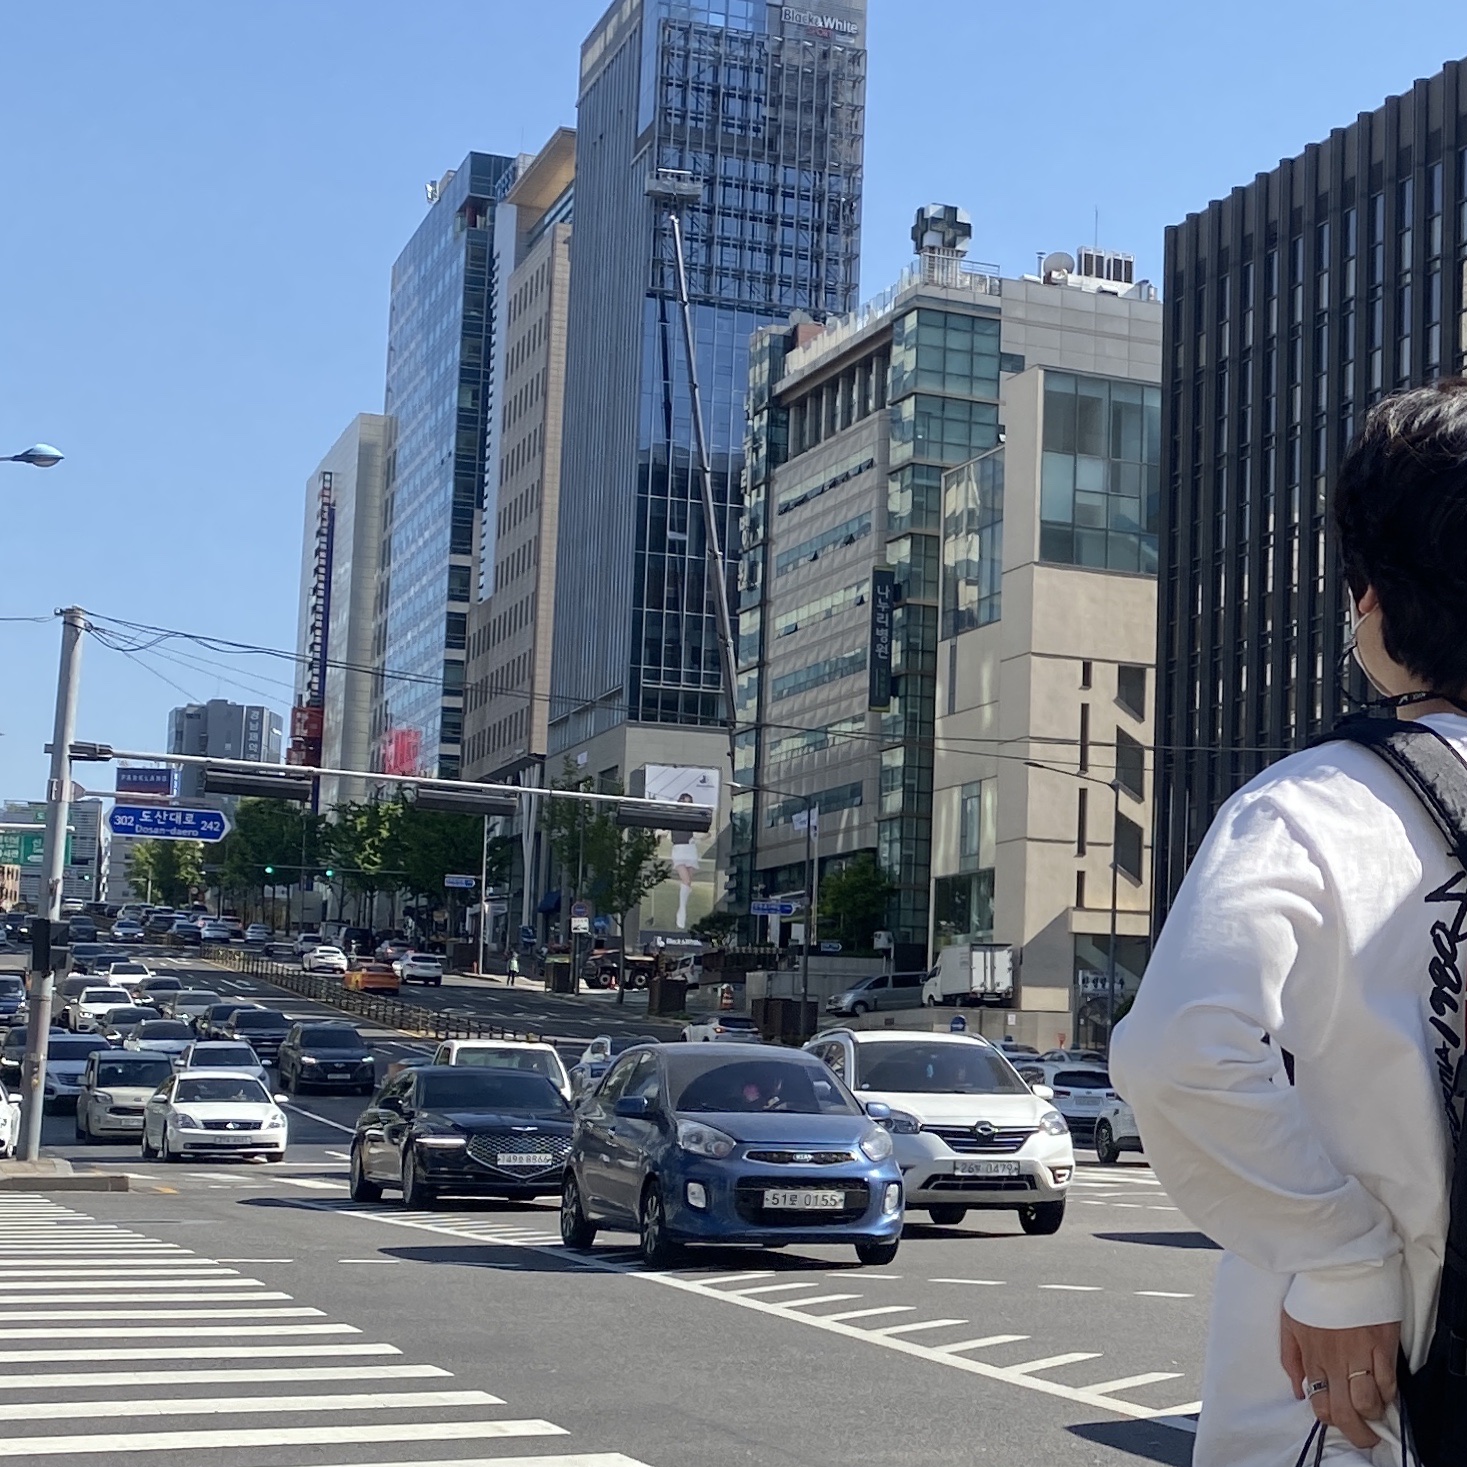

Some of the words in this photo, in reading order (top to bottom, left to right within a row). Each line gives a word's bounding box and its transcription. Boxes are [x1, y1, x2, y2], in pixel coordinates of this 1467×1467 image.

[876, 585, 890, 659] 나누리병원
[114, 814, 134, 826] 302
[139, 810, 196, 825] 도산대로
[201, 820, 221, 832] 242
[135, 824, 199, 837] Dosan-daero
[804, 1193, 838, 1207] 0155
